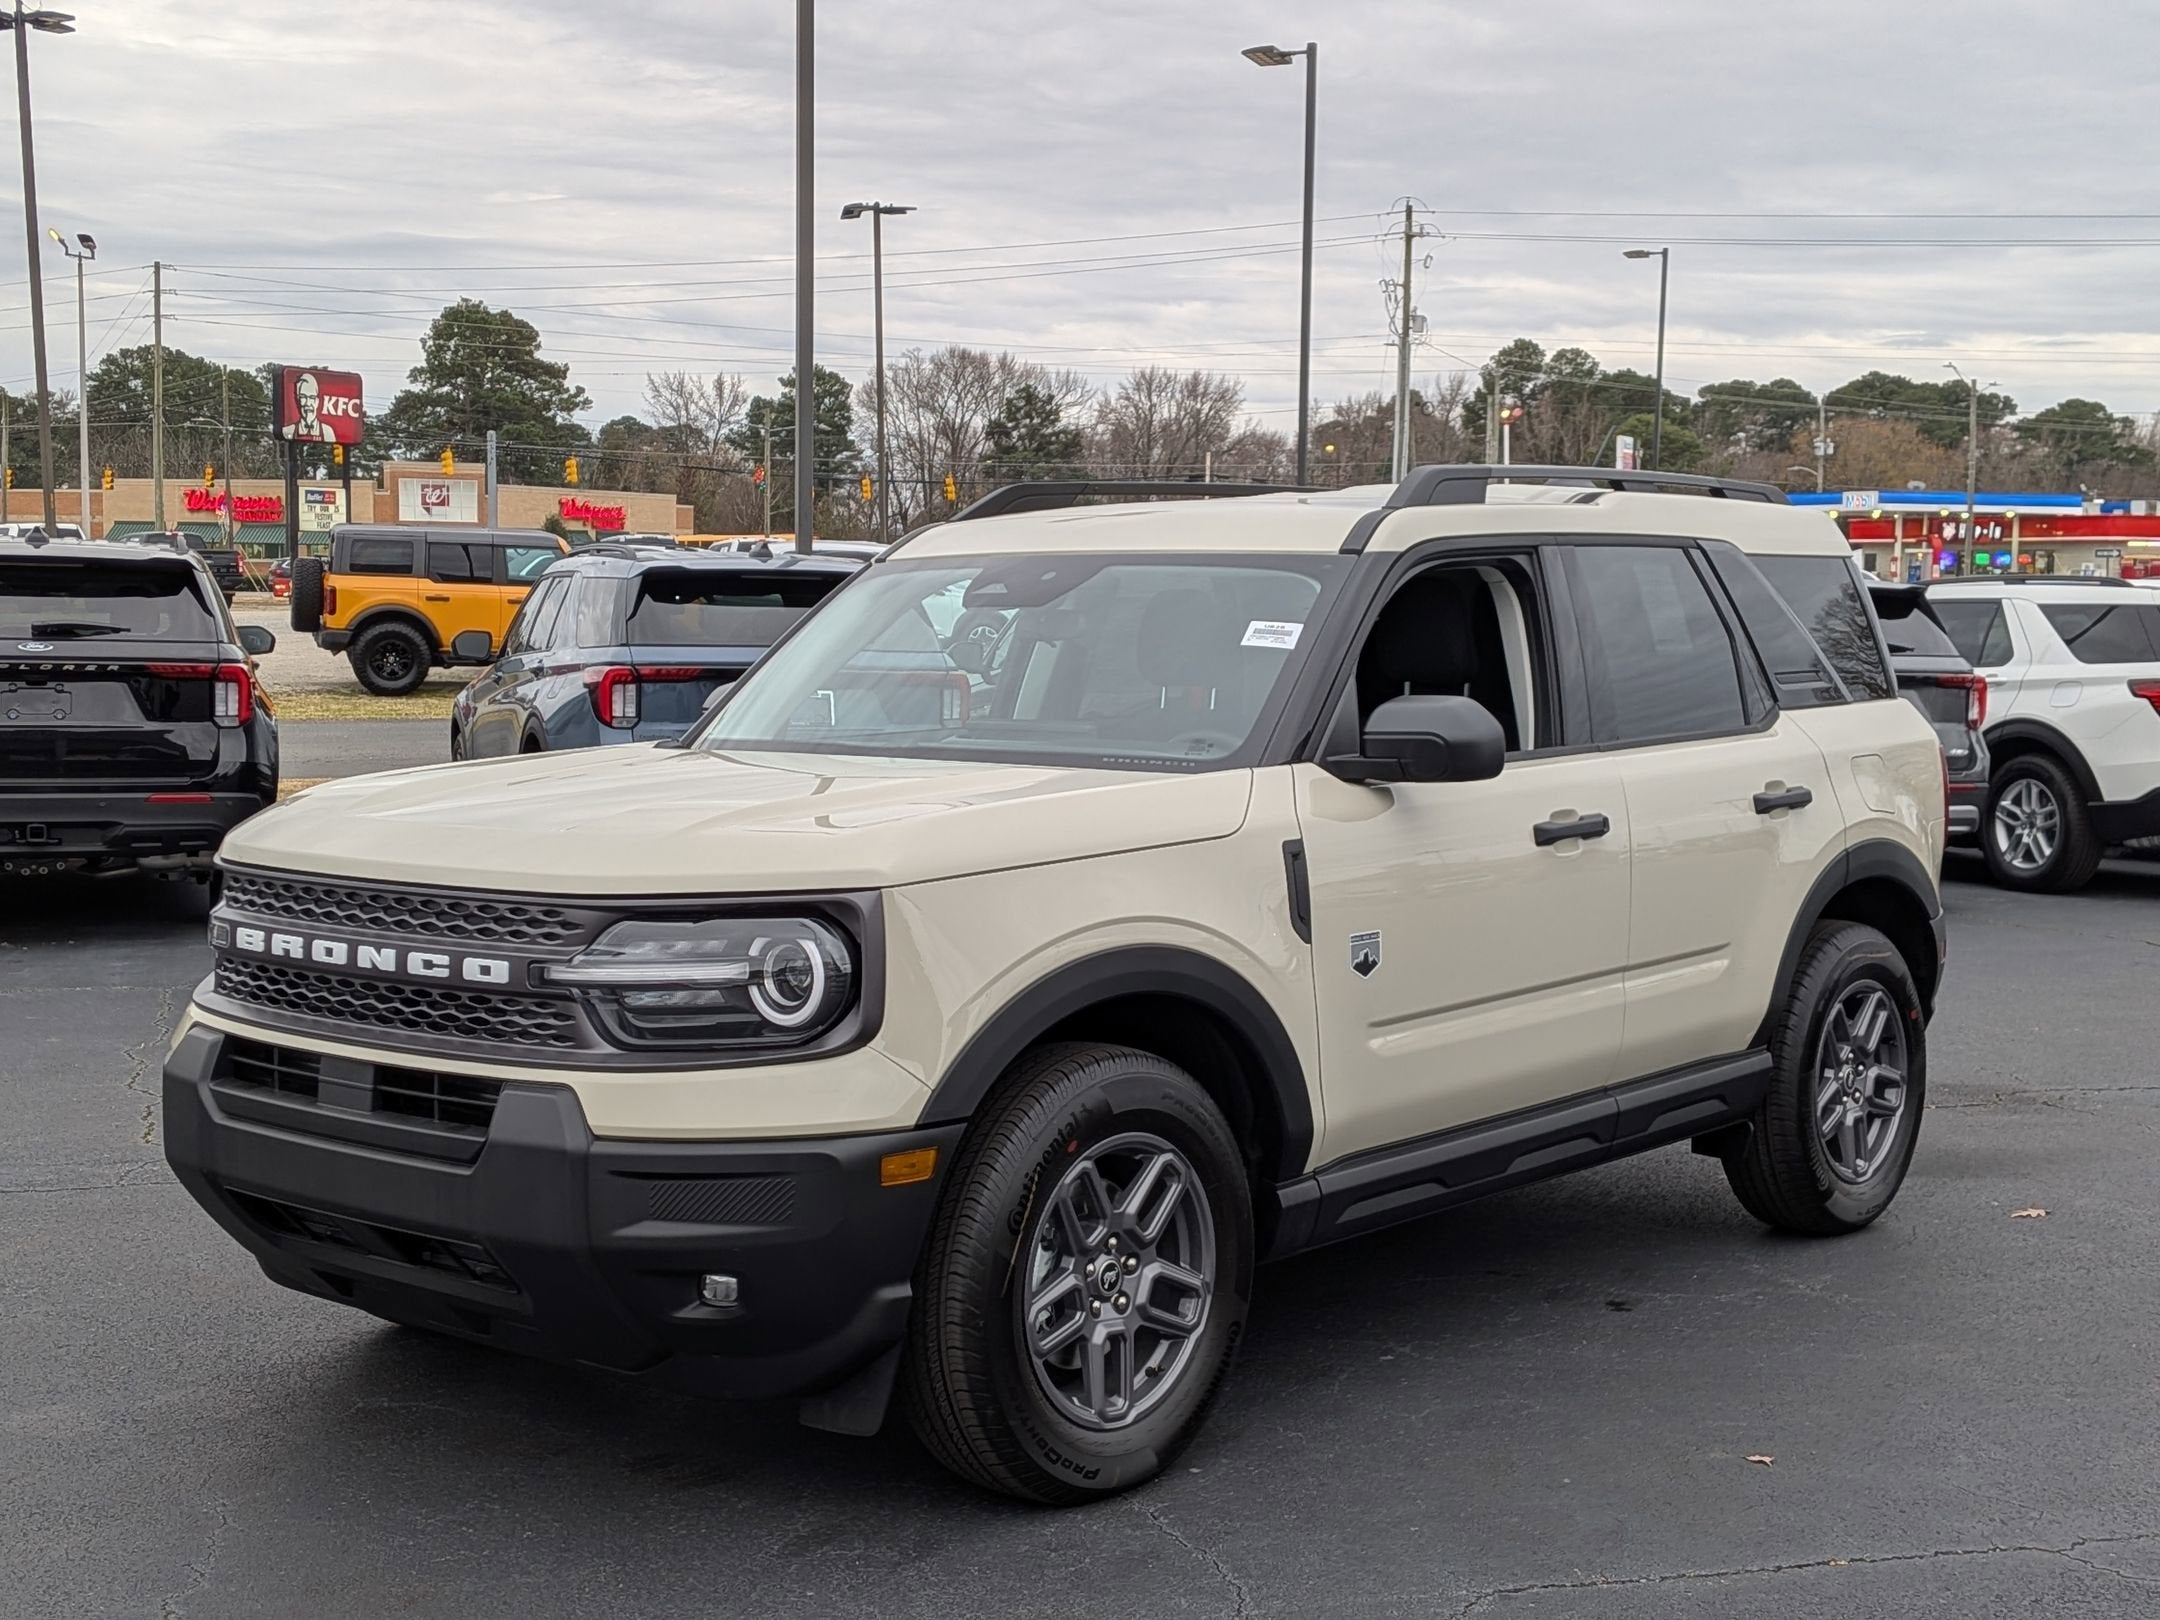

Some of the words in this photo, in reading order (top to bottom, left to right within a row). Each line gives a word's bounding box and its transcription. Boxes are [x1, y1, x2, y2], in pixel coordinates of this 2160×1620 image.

[322, 395, 360, 418] KFC
[183, 487, 284, 512] Walreens
[1846, 495, 1873, 508] Mobil
[236, 927, 509, 984] BRONCO
